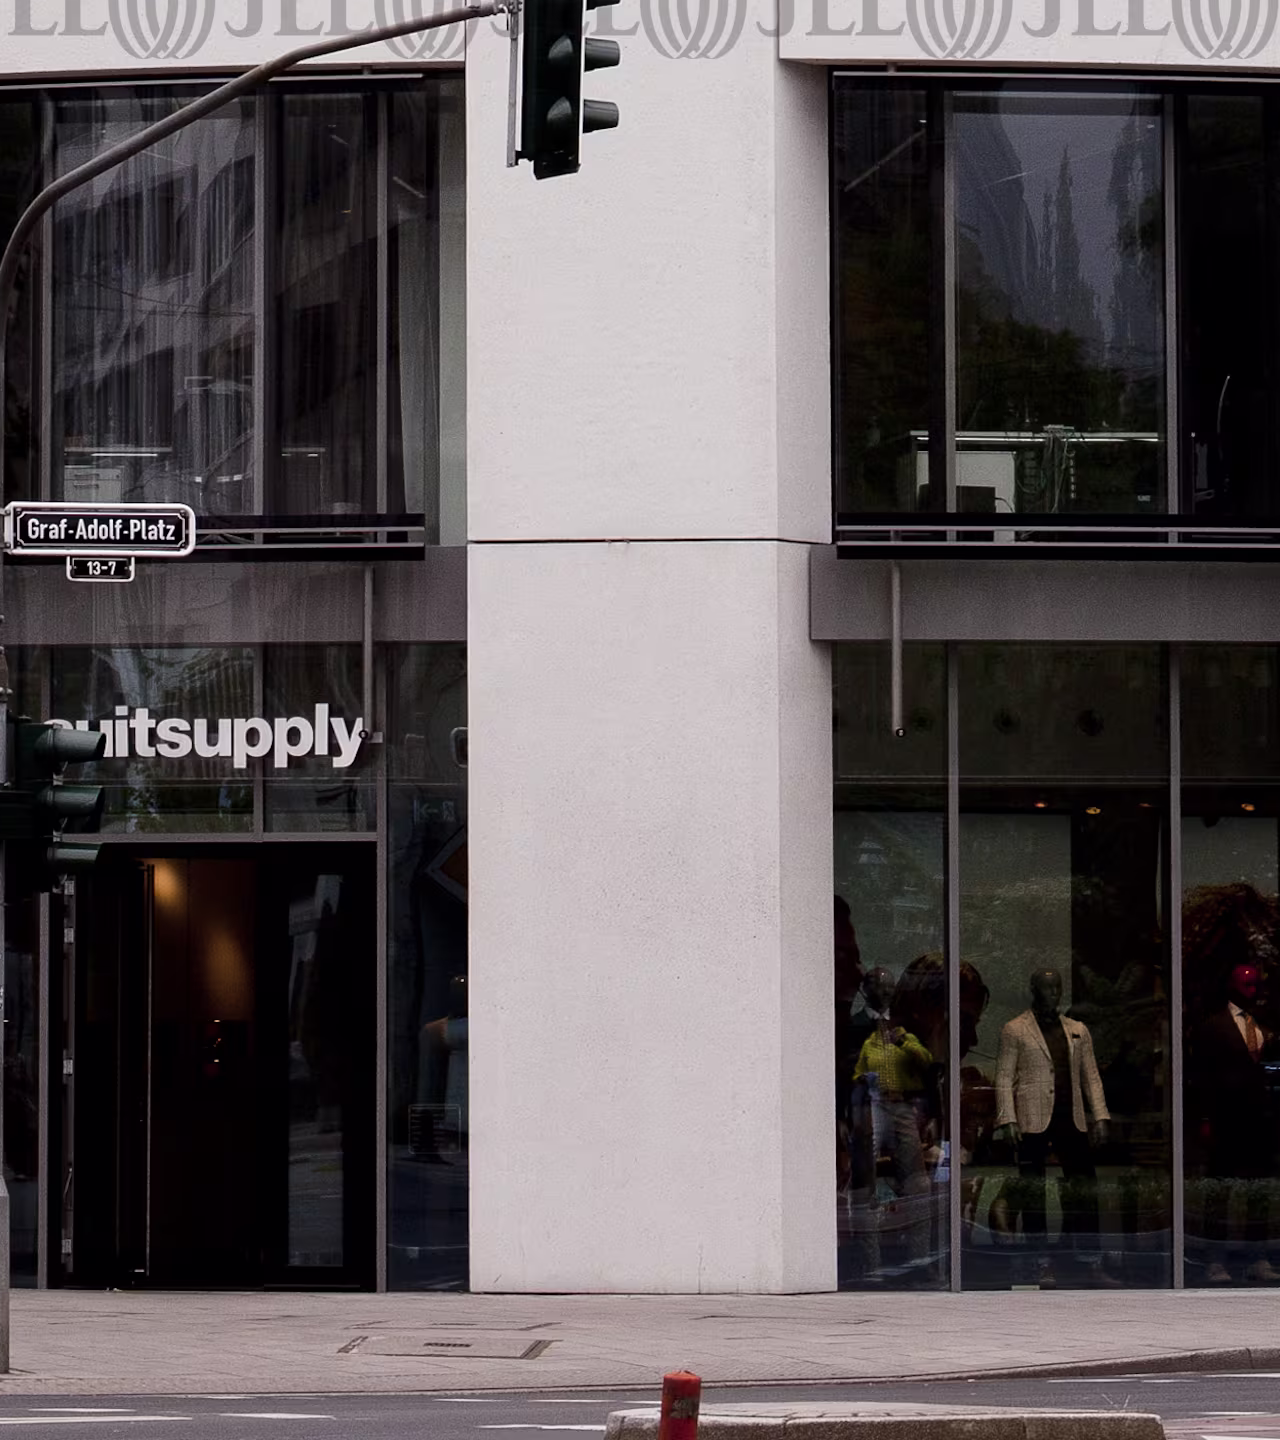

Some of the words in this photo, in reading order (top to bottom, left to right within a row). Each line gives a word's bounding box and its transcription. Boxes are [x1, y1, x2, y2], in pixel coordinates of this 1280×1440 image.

[27, 517, 176, 541] Graf-Adolf-Platz
[86, 561, 117, 576] 13-7
[43, 702, 365, 769] uitsupply
